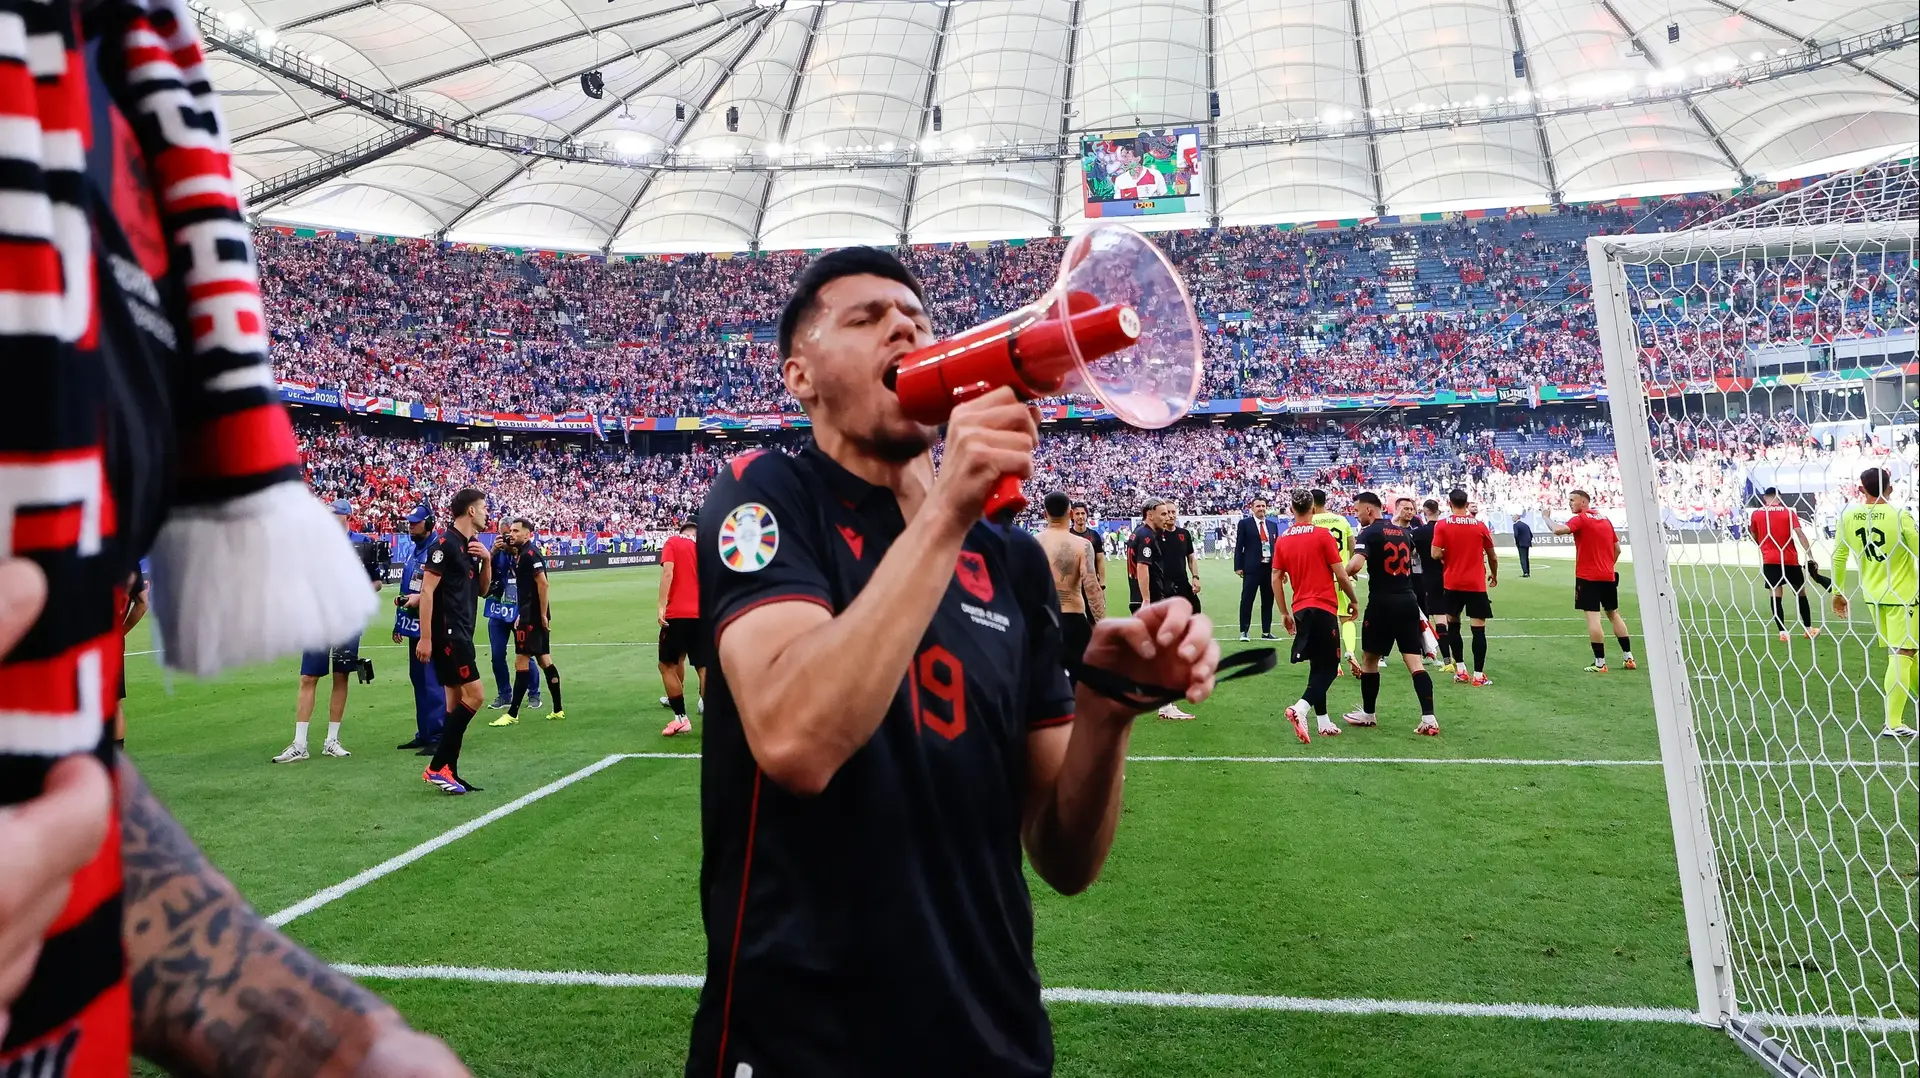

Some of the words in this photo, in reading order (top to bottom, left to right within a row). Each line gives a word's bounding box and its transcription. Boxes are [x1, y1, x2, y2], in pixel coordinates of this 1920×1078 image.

[1446, 516, 1478, 526] ALBANIA
[1853, 512, 1886, 521] KASRATI
[1281, 525, 1314, 538] ALBANIA
[1553, 536, 1575, 544] EVER
[1854, 526, 1887, 563] 12
[1383, 541, 1411, 577] 22
[907, 644, 967, 741] 19
